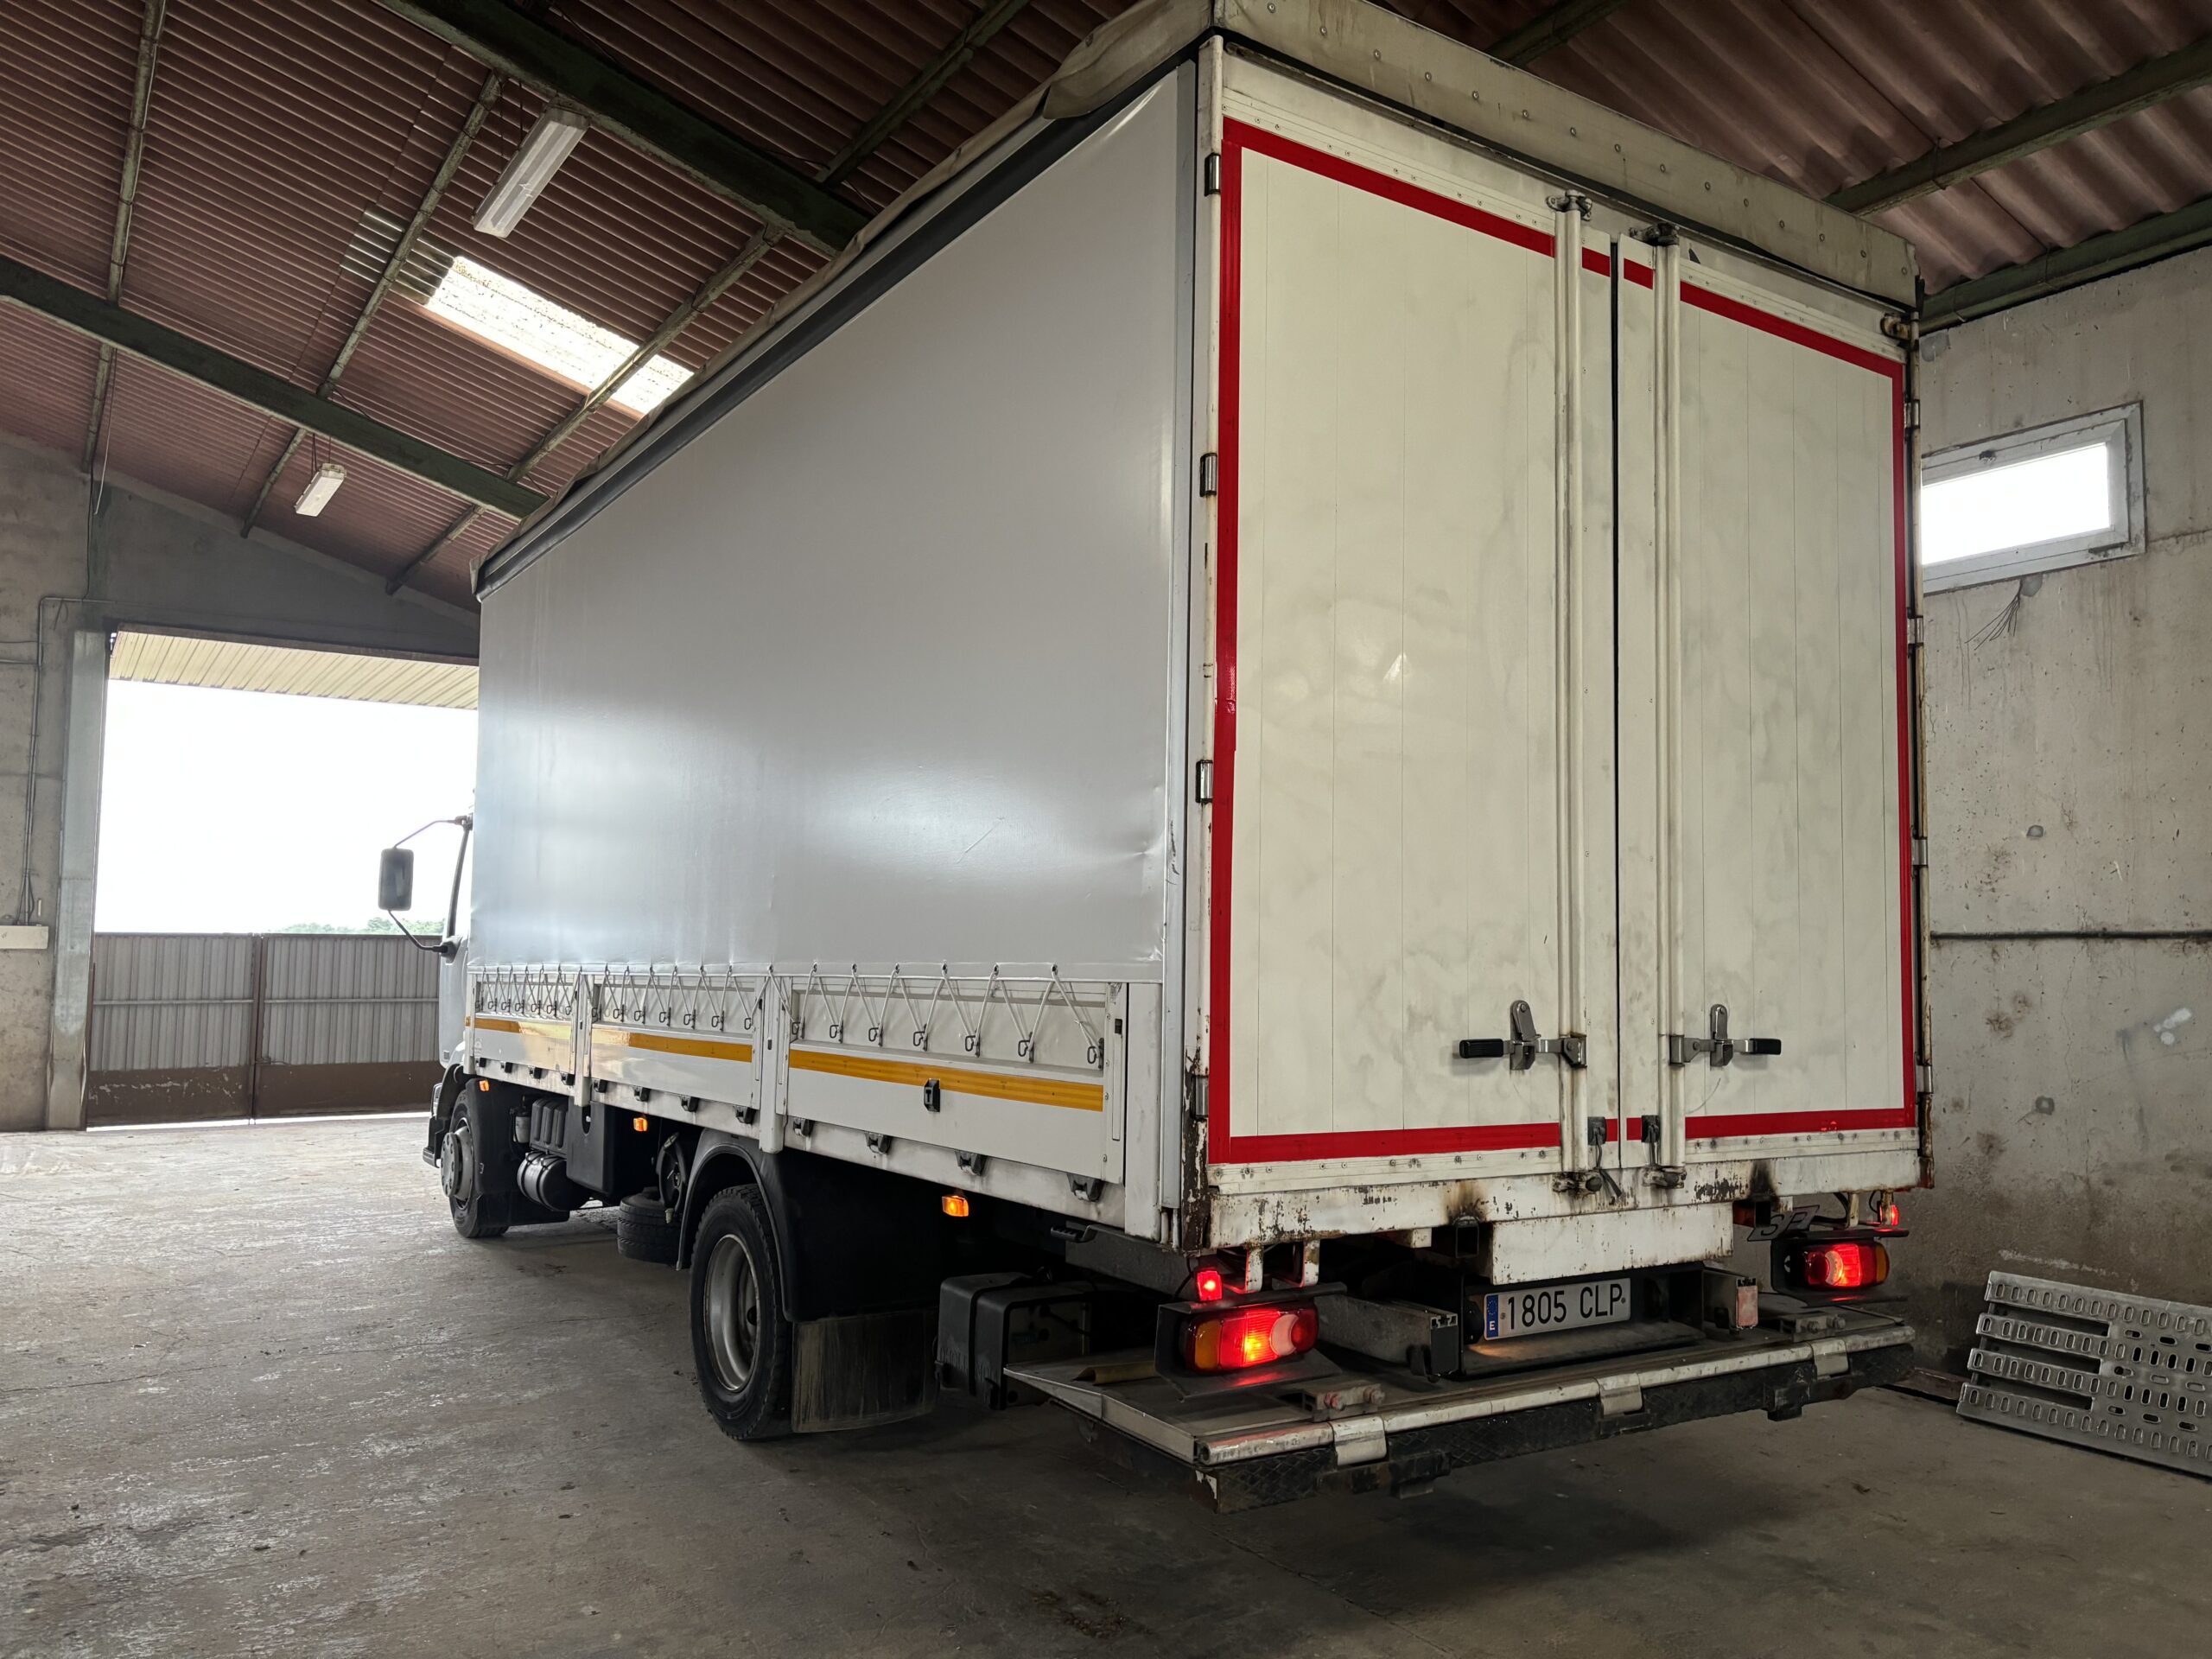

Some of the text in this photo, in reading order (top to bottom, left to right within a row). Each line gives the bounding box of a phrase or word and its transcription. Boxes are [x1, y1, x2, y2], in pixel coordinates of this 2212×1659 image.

[1508, 1283, 1623, 1330] 1805 CLP
[1489, 1320, 1496, 1331] E
